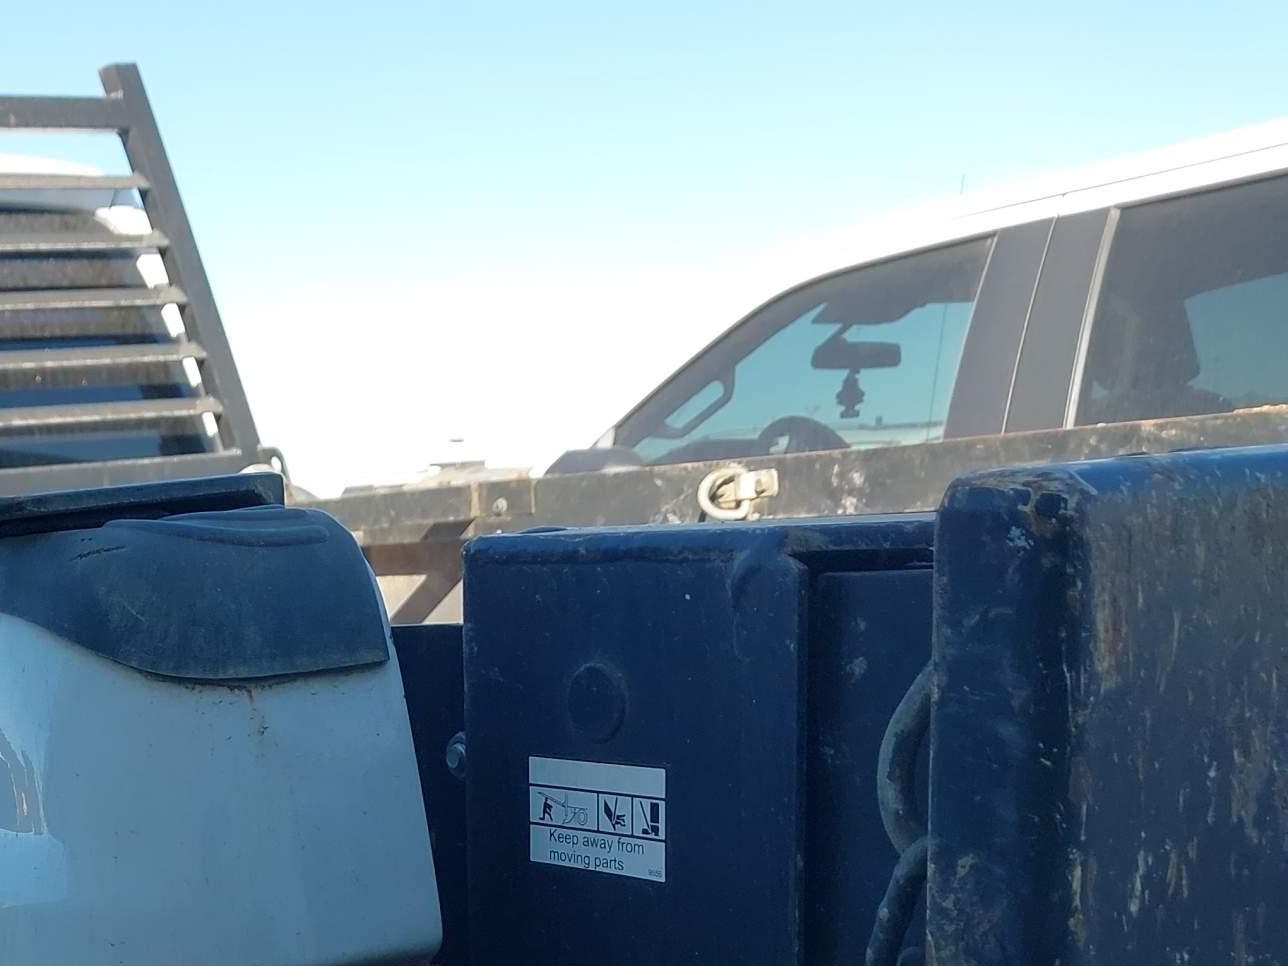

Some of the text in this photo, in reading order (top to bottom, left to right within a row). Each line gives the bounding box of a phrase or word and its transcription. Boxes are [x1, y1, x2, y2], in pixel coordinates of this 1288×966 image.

[548, 828, 645, 855] Keep away from
[548, 849, 625, 871] moving parts
